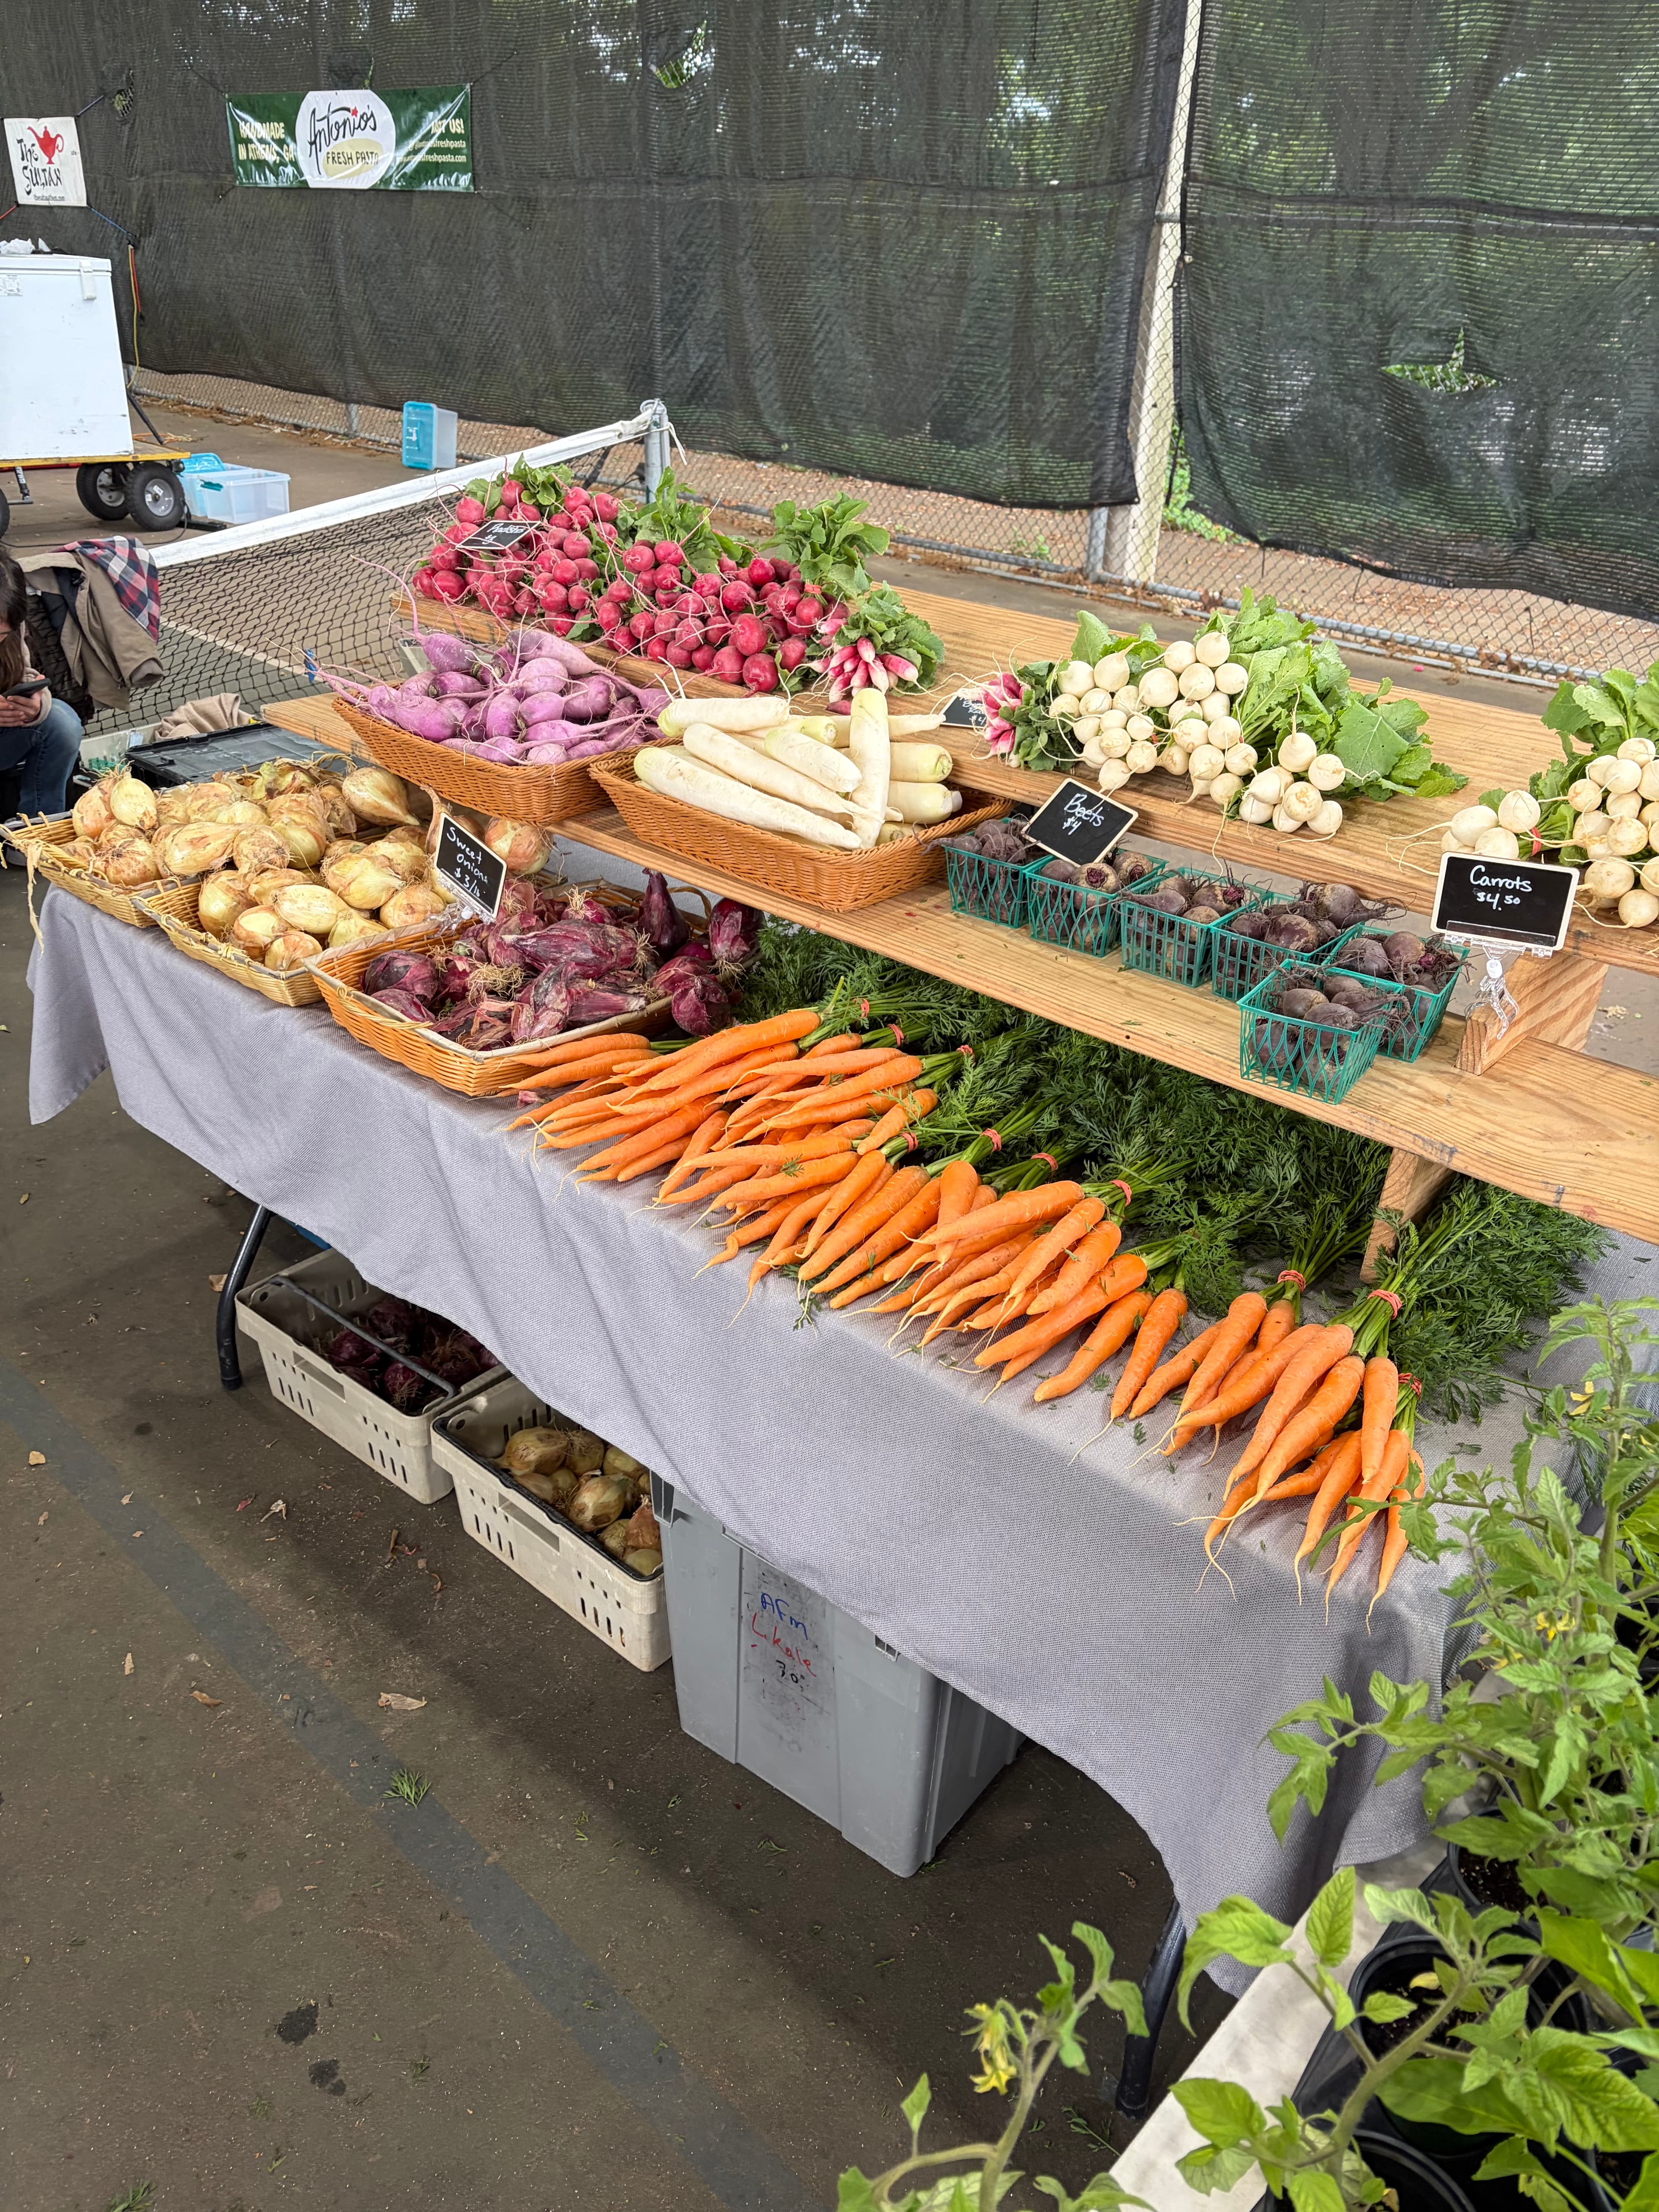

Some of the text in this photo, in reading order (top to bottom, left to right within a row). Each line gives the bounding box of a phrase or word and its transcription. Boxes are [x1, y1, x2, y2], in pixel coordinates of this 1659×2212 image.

[239, 121, 285, 140] HANDMADE
[448, 118, 465, 134] US!
[307, 102, 377, 175] Antonio's
[238, 143, 295, 164] IN ATHENS, GA
[326, 151, 354, 165] FRESH
[1064, 793, 1104, 826] Beets
[1062, 816, 1082, 836] $4
[447, 827, 482, 864] Sweet
[1470, 865, 1532, 892] Carrots
